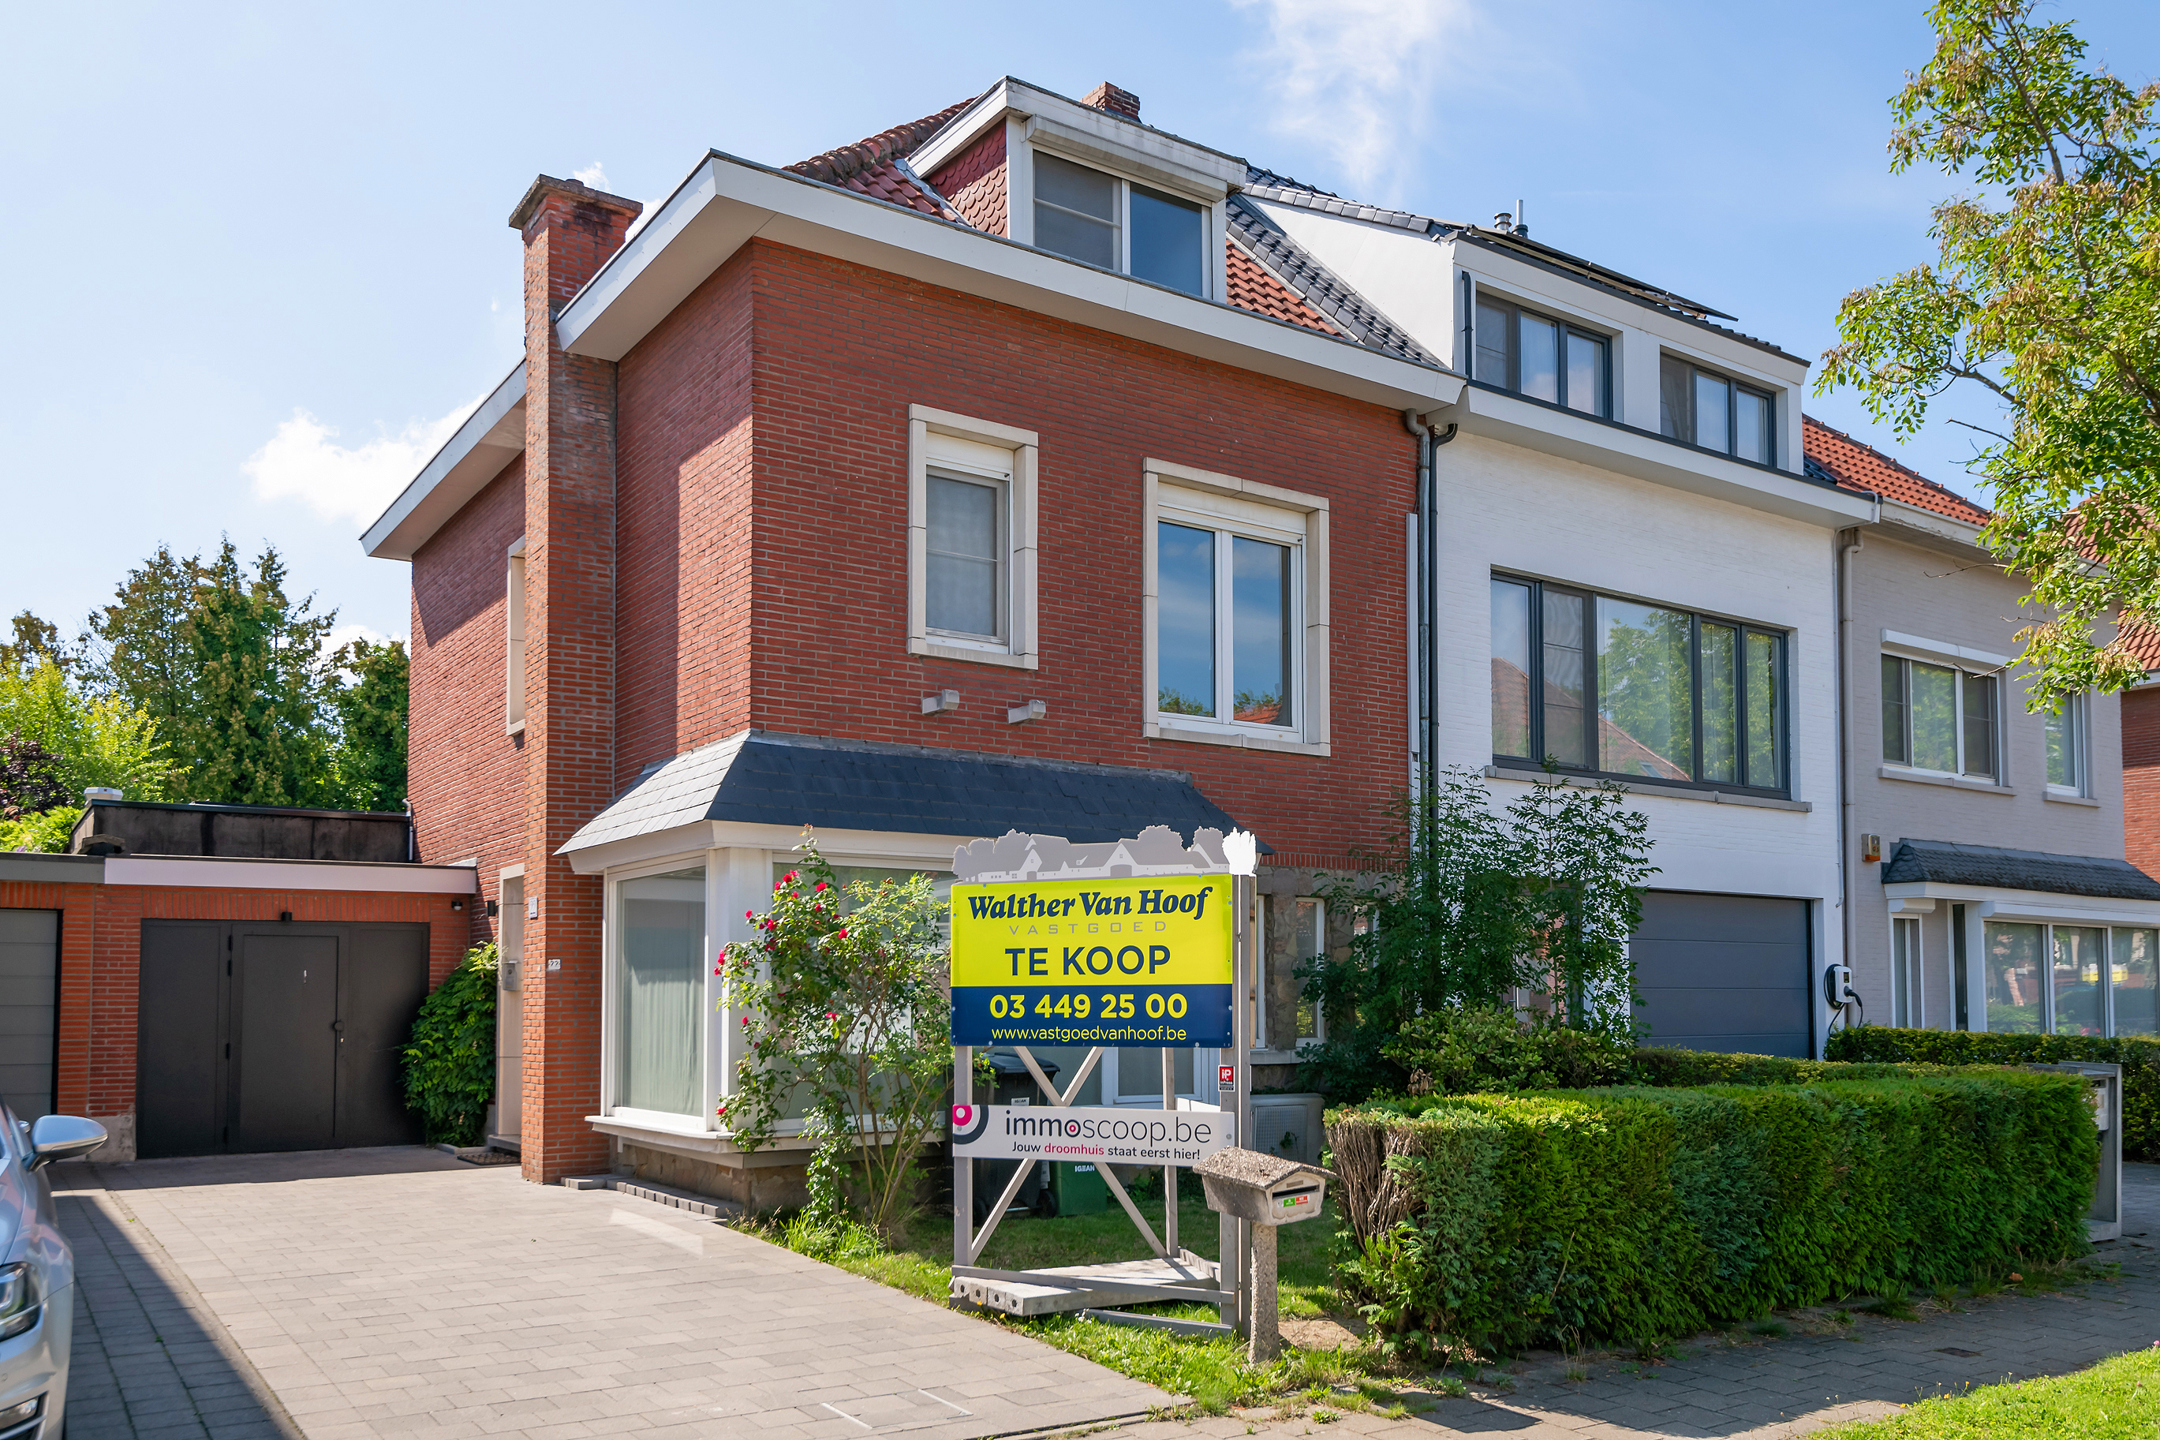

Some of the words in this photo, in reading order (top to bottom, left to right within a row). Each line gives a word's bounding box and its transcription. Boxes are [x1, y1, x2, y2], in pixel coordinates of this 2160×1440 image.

[968, 893, 1075, 919] Walther
[1079, 891, 1132, 916] Van
[1137, 886, 1213, 920] Hoof
[1009, 921, 1166, 935] VASTGOED
[1005, 948, 1048, 976] TE
[1063, 945, 1171, 976] KOOP
[989, 994, 1026, 1019] 03
[1034, 993, 1091, 1019] 449
[1100, 993, 1136, 1019] 25
[1145, 993, 1188, 1019] 00
[991, 1026, 1187, 1042] www.vastgoedvanhoof.be
[1005, 1109, 1212, 1147] immoscoop.be
[1012, 1141, 1041, 1153] Jouw
[1044, 1142, 1105, 1156] droomhuis
[1107, 1146, 1138, 1158] staat
[1140, 1147, 1170, 1159] eerst
[1173, 1148, 1201, 1160] hier!
